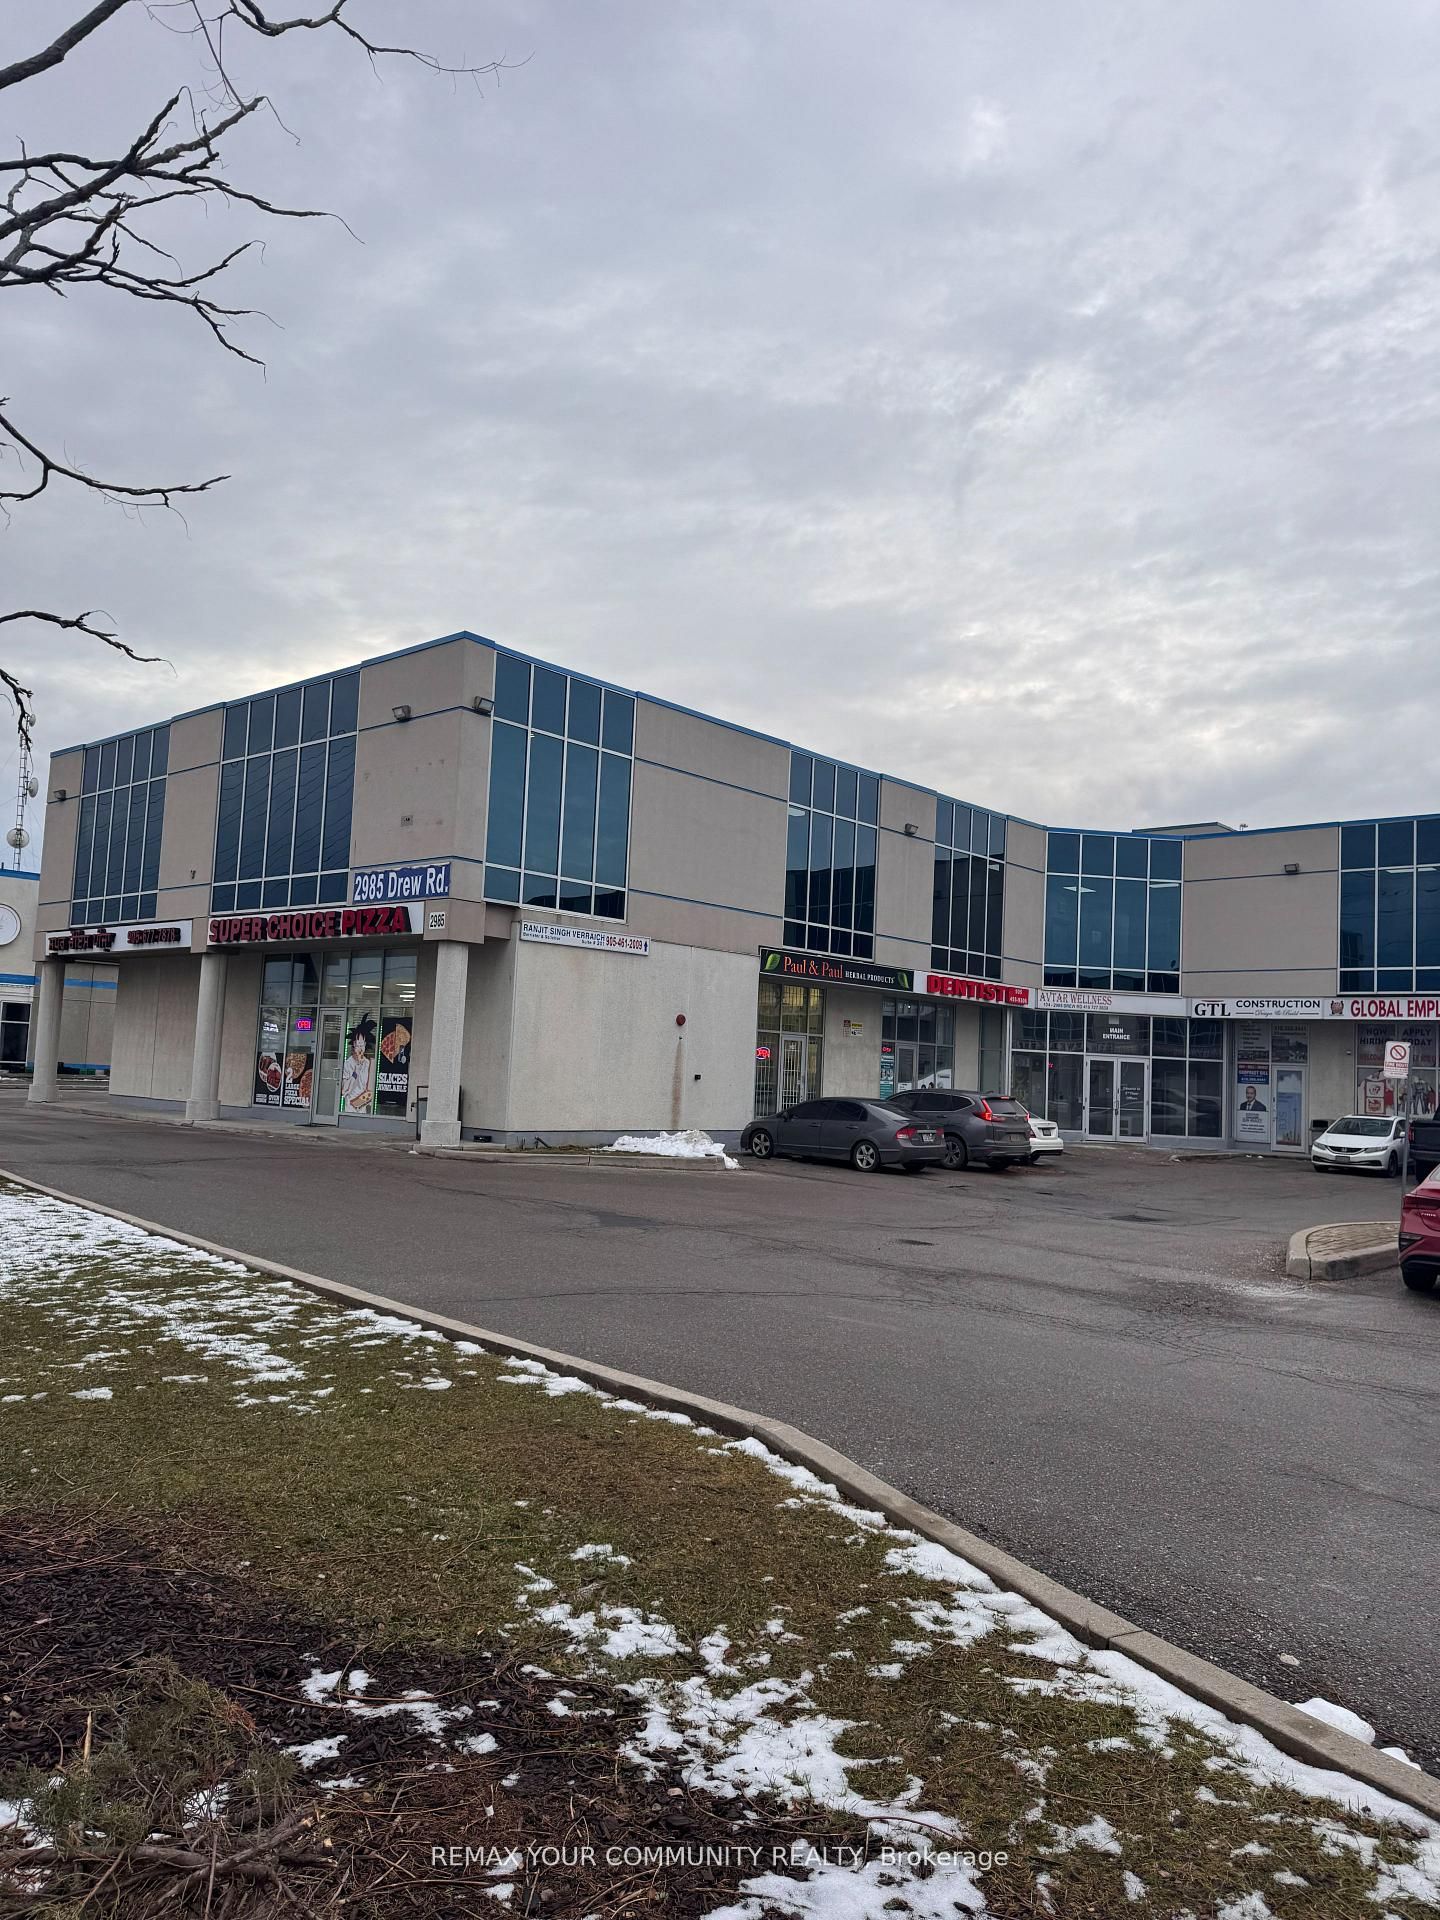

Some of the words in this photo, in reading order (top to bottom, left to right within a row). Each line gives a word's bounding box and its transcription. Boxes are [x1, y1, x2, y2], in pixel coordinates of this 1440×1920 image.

[354, 873, 385, 901] 2985
[388, 871, 423, 898] Drew
[425, 866, 449, 895] Rd.
[208, 917, 268, 943] SUPER
[267, 910, 341, 940] CHOICE
[341, 905, 412, 935] PIZZA
[429, 914, 445, 928] 2985
[523, 923, 549, 935] RANJIT
[550, 927, 571, 937] SINGH
[572, 930, 605, 941] VERRAICH
[783, 956, 807, 974] Paul
[808, 960, 819, 976] &
[821, 961, 843, 979] Paul
[845, 970, 867, 981] HERBAL
[867, 974, 896, 985] PRODUCTS
[926, 975, 1006, 1003] DENTIST
[1039, 992, 1069, 1004] AVTAR
[1070, 993, 1113, 1006] WELLNESS
[1194, 1002, 1231, 1017] GTL
[1235, 1000, 1321, 1009] CONSTRUCTION
[1350, 999, 1404, 1018] GLOBAL
[1402, 1028, 1432, 1037] APPLY
[285, 1067, 293, 1084] 2
[378, 1072, 408, 1085] SLICES
[284, 1096, 310, 1107] SPECIAL
